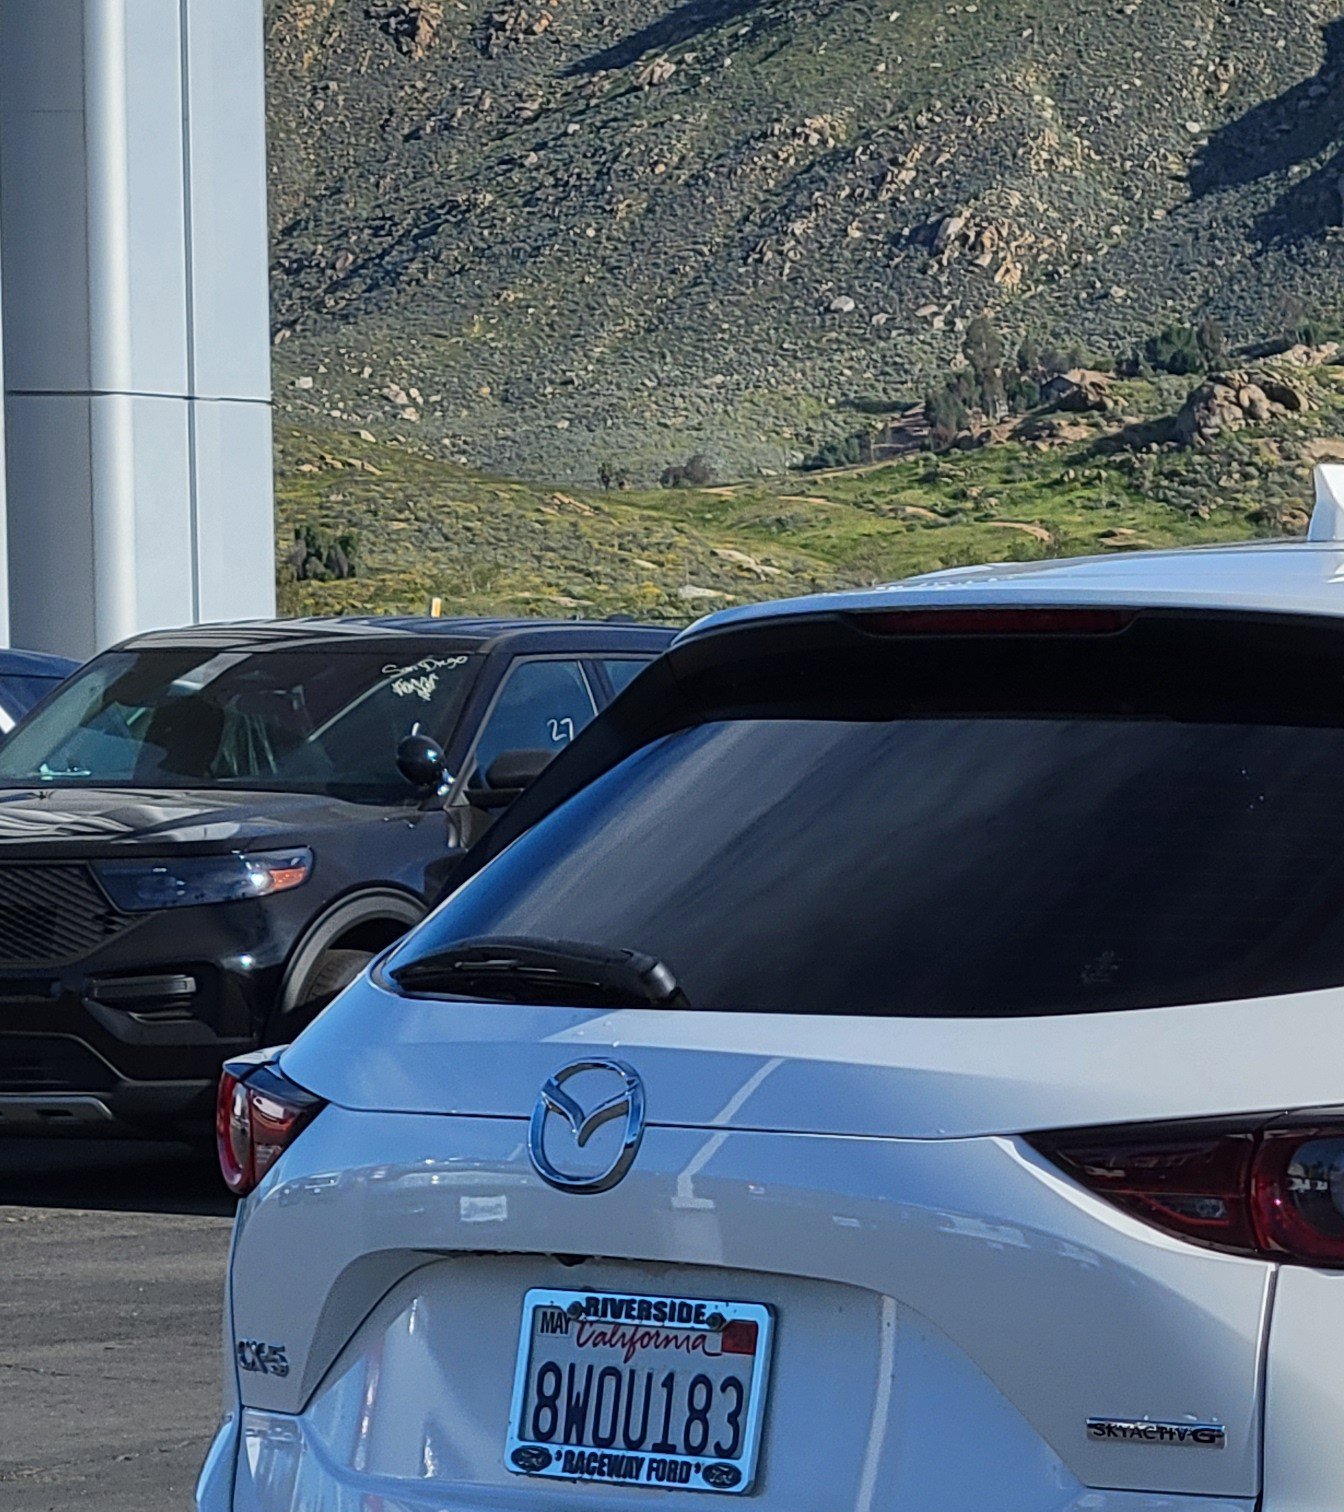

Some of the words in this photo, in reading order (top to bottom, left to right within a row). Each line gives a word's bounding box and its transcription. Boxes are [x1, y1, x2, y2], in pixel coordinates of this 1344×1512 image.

[540, 1311, 570, 1335] MAY
[584, 1296, 707, 1324] RIVERSIDE
[575, 1320, 722, 1363] California
